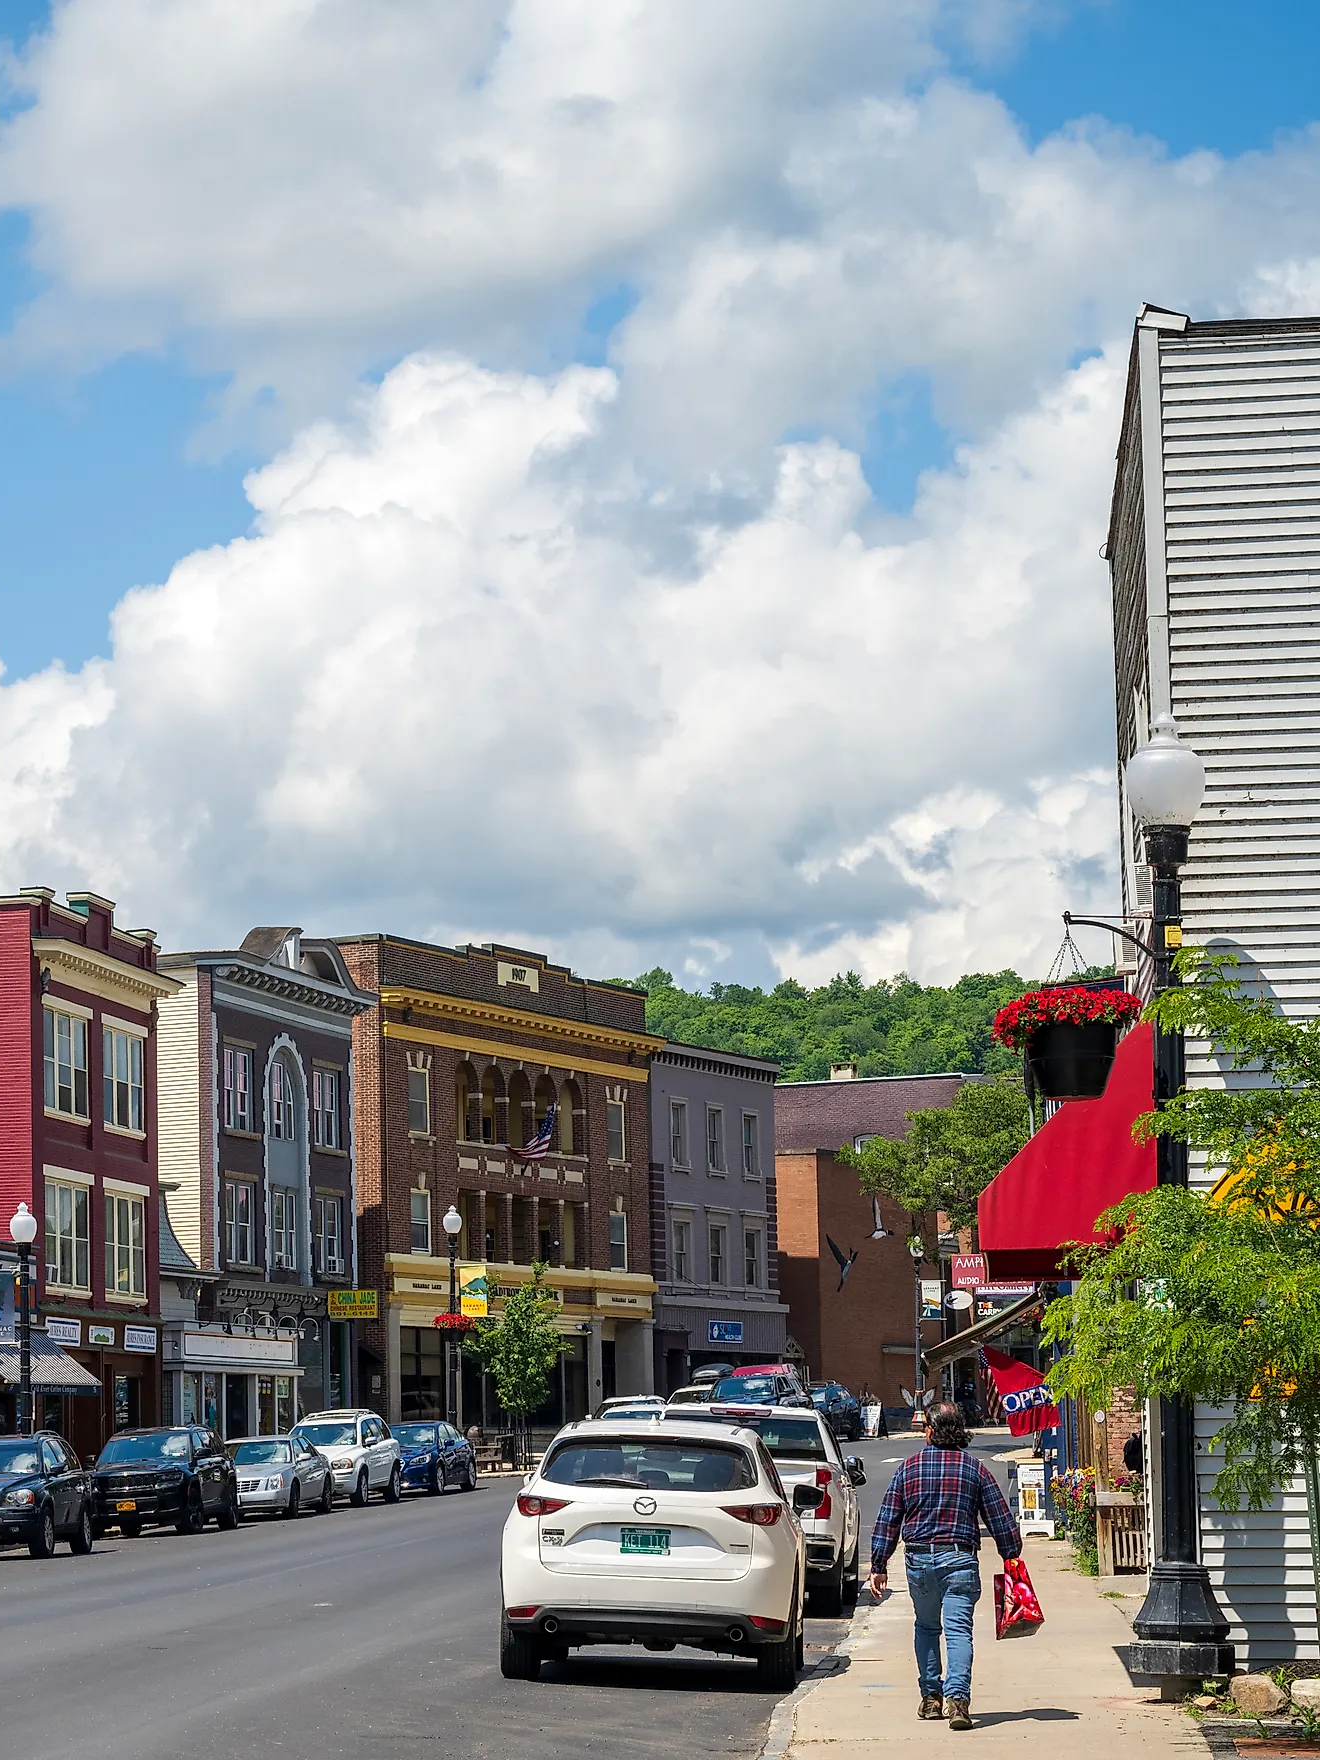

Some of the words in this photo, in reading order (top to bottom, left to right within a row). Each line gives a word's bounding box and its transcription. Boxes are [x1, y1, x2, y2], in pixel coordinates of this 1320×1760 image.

[511, 967, 527, 982] 1907
[957, 1276, 980, 1285] AUDIO
[337, 1291, 357, 1305] CHINA
[359, 1291, 376, 1304] JADE
[61, 1386, 78, 1395] Company
[1002, 1387, 1055, 1412] OPEN
[624, 1534, 642, 1548] KET
[648, 1535, 667, 1549] 114
